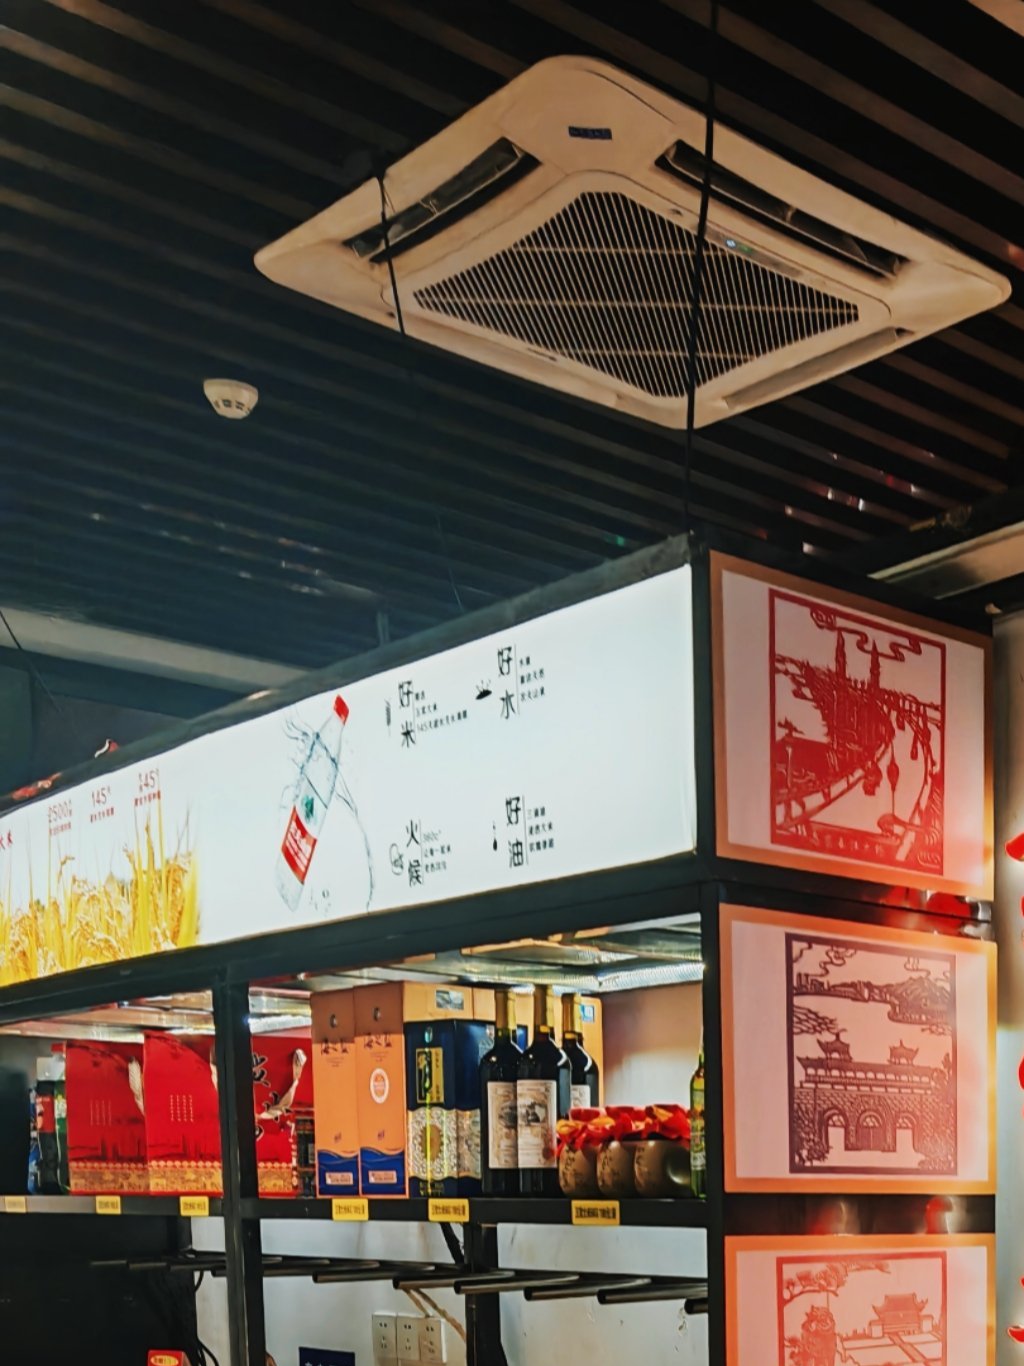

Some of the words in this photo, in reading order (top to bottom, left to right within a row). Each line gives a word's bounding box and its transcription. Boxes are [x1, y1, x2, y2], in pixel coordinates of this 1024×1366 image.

[398, 681, 415, 747] 好米
[497, 646, 515, 720] 好水
[505, 796, 523, 868] 好油
